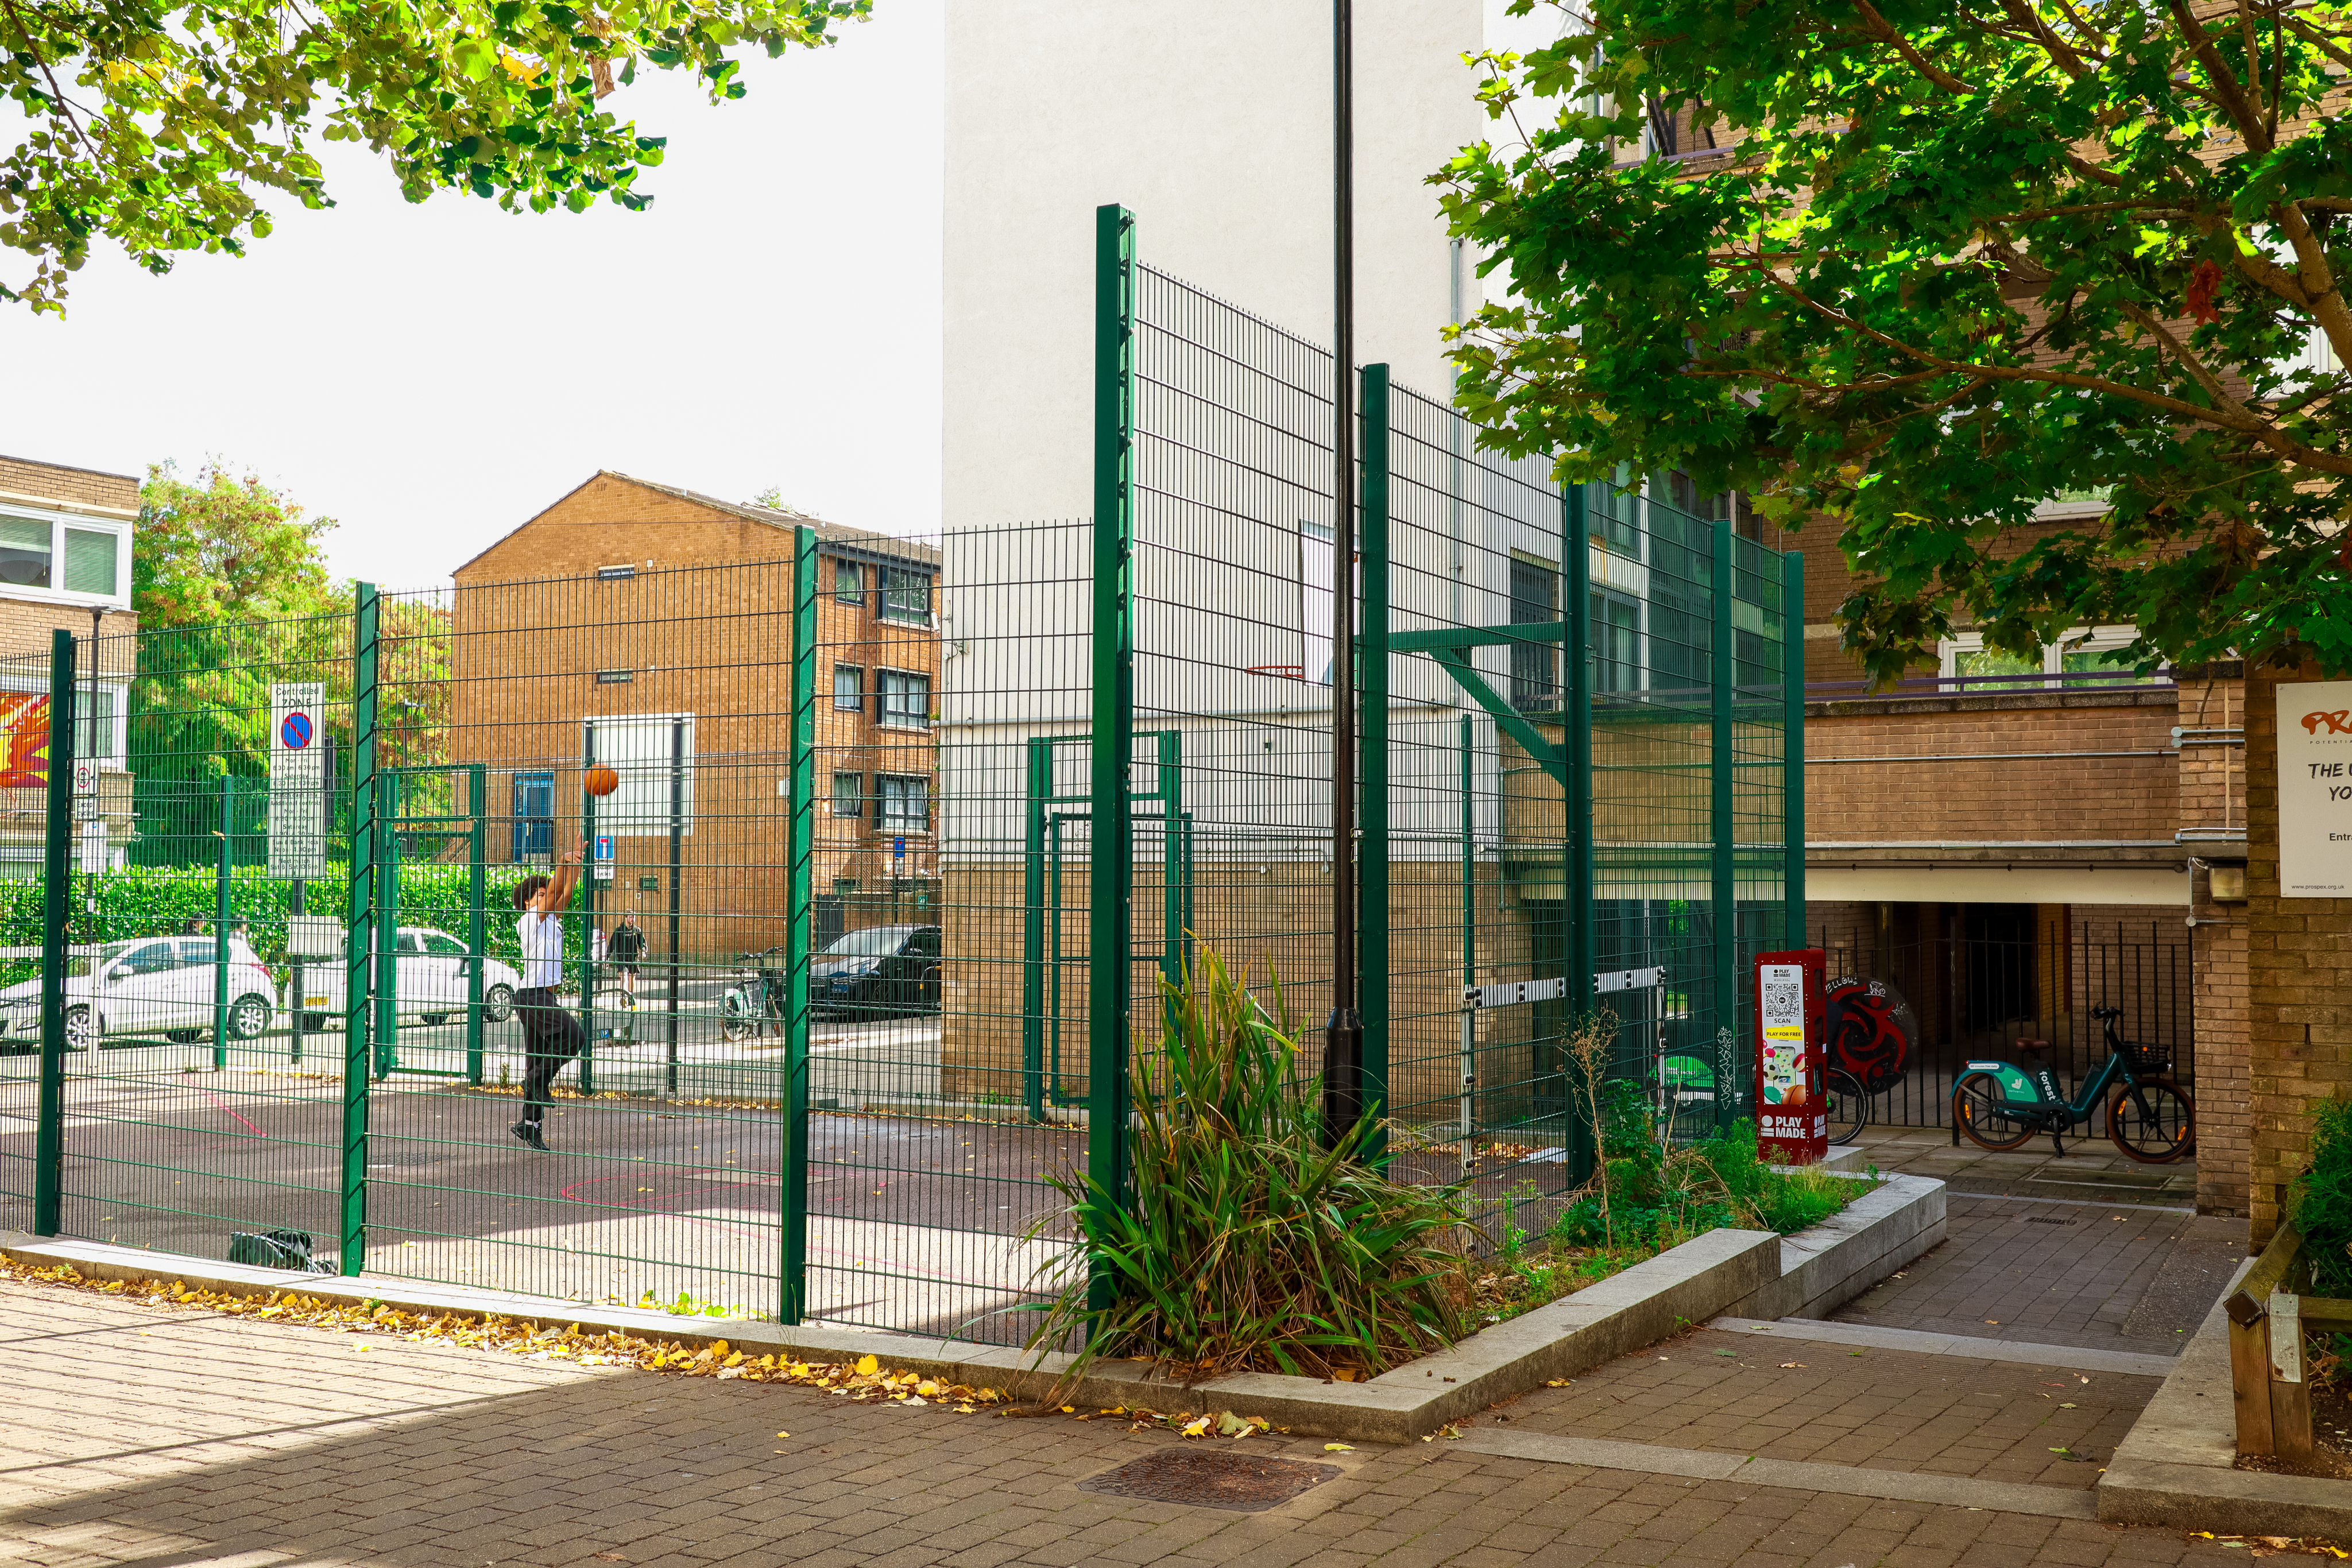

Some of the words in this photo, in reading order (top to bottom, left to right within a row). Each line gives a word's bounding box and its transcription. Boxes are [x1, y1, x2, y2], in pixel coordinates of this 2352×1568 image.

[276, 687, 319, 695] Controlled
[283, 698, 312, 708] ZONE
[2308, 763, 2343, 779] THE
[2329, 833, 2352, 841] Entr
[2039, 1071, 2056, 1101] forest
[1776, 1116, 1802, 1128] PLAY
[1776, 1127, 1806, 1139] MADE
